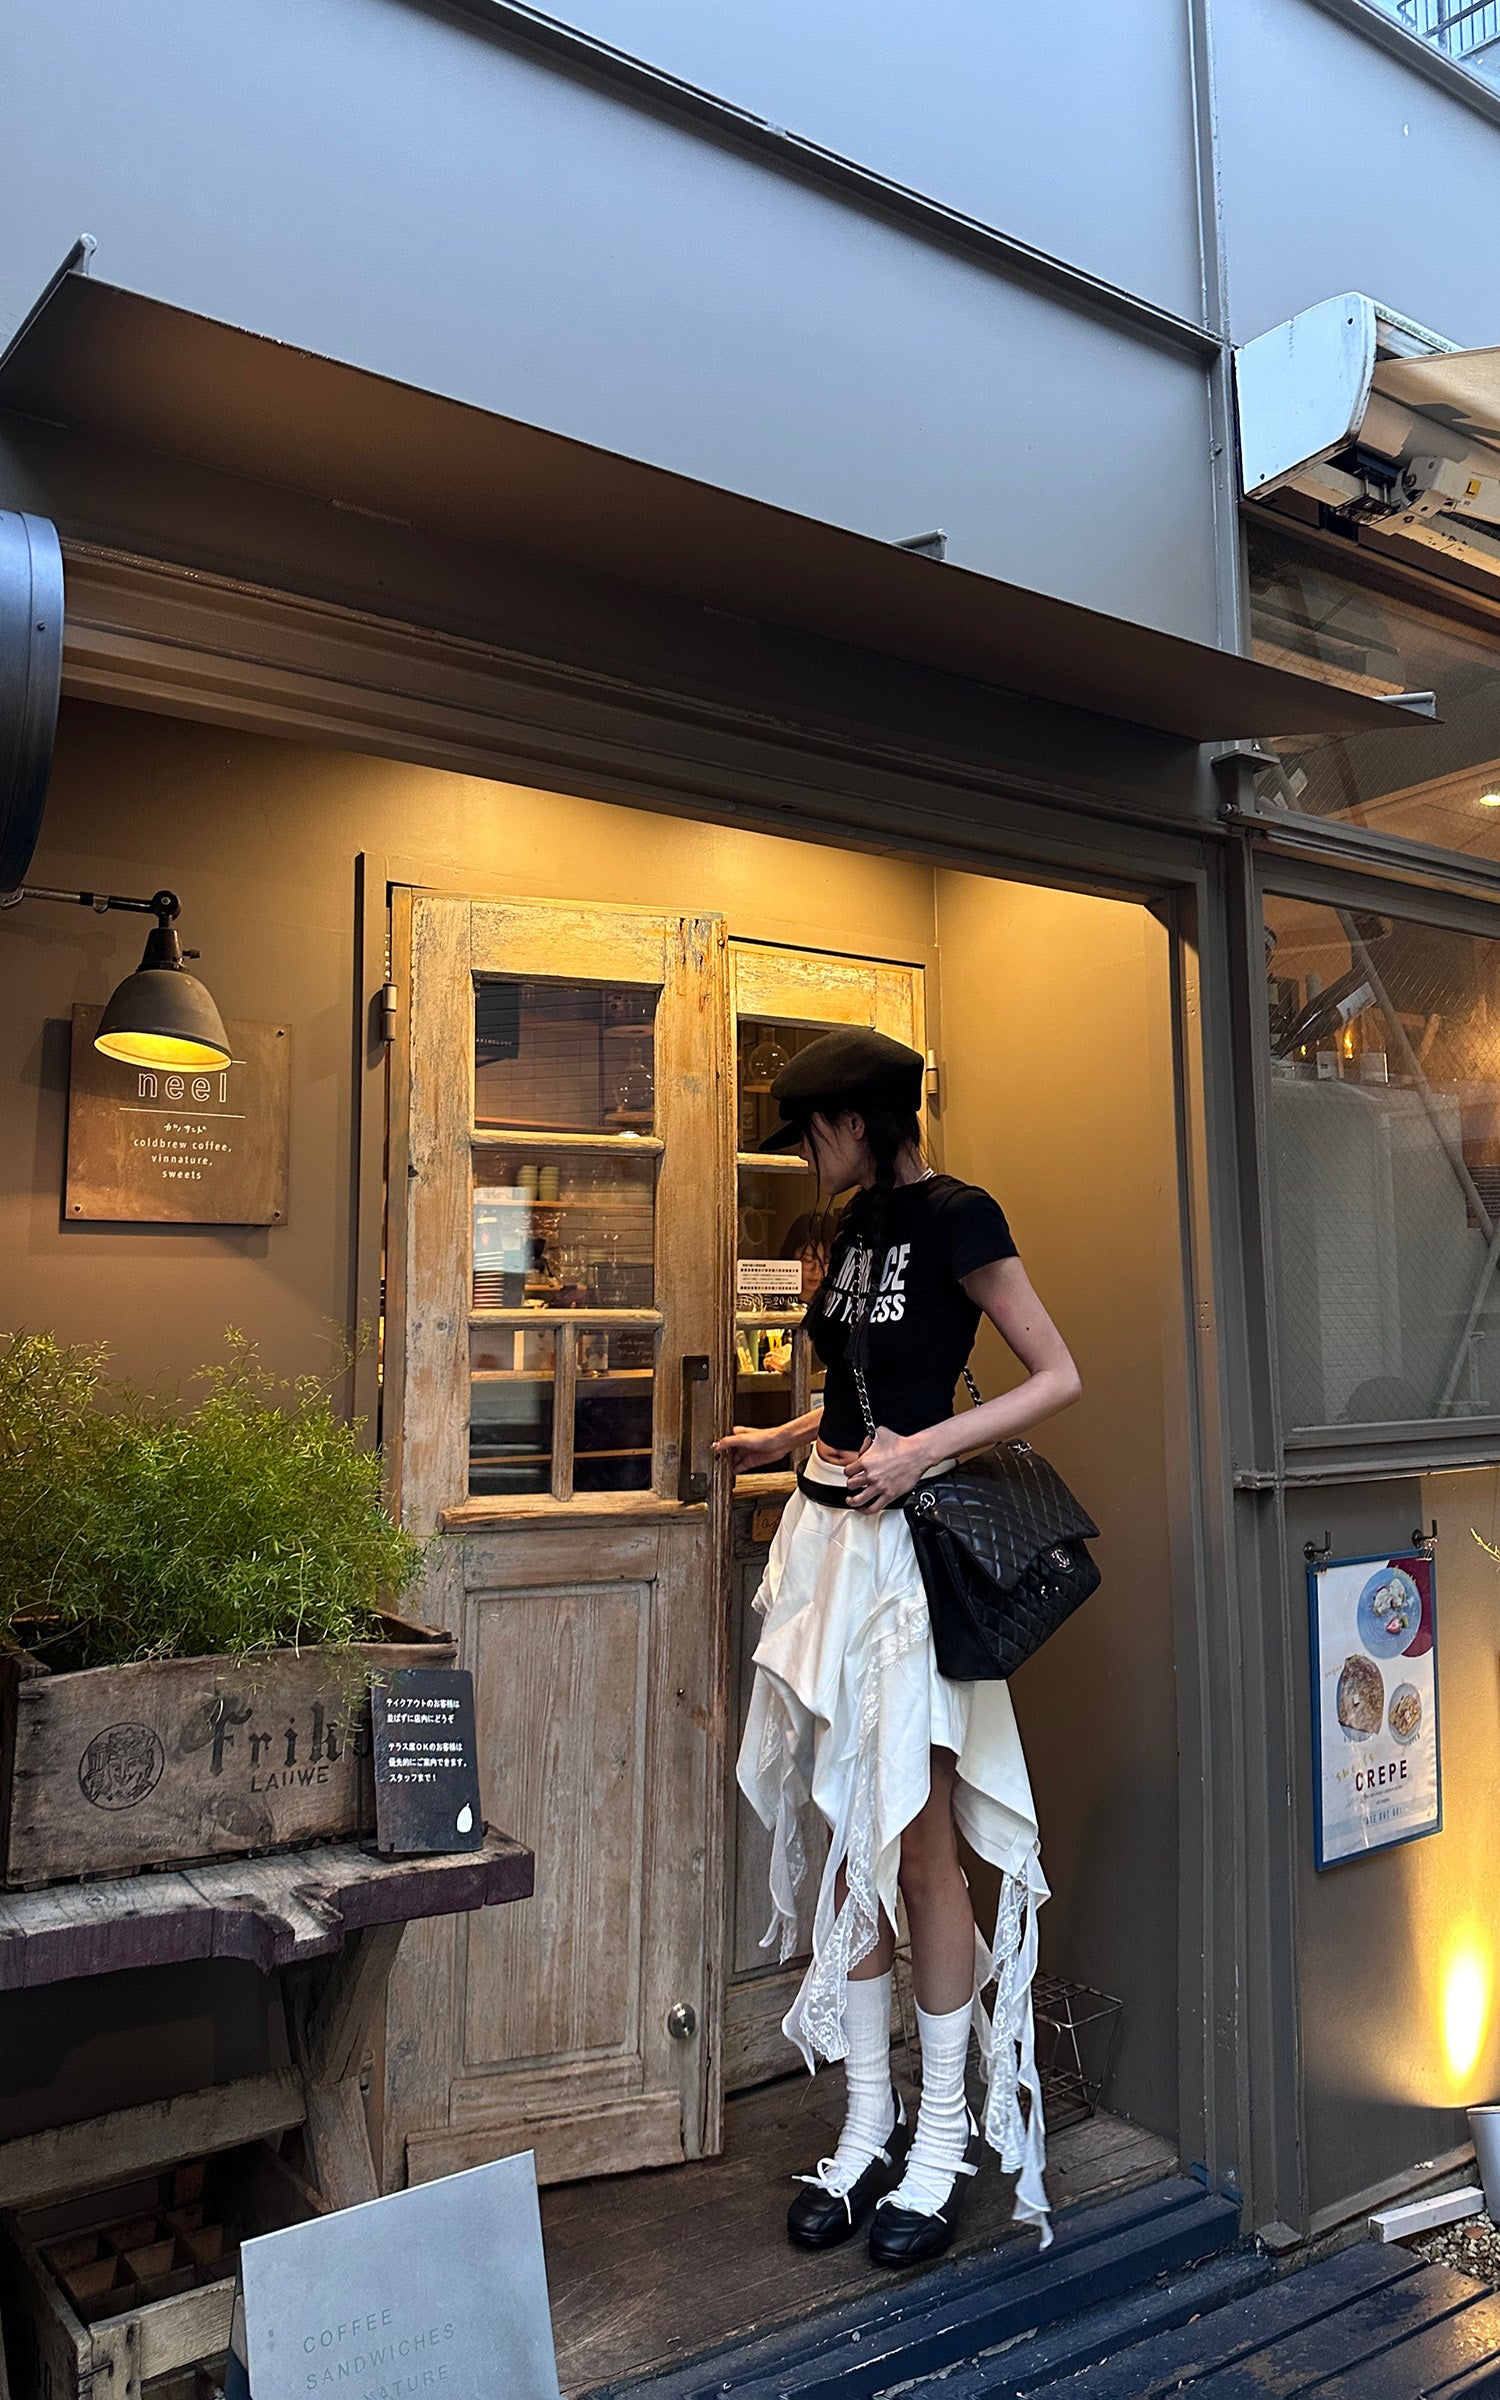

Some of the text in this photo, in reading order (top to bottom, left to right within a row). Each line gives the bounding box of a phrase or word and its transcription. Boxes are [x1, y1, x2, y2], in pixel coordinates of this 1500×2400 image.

[138, 1072, 227, 1103] neel
[133, 1137, 232, 1153] coldbrew coffee,
[151, 1153, 213, 1166] vinnature,
[162, 1170, 202, 1180] sweets
[1355, 1759, 1408, 1792] CREPE
[302, 2307, 393, 2354] COFFEE
[305, 2322, 455, 2391] SANDWICHES
